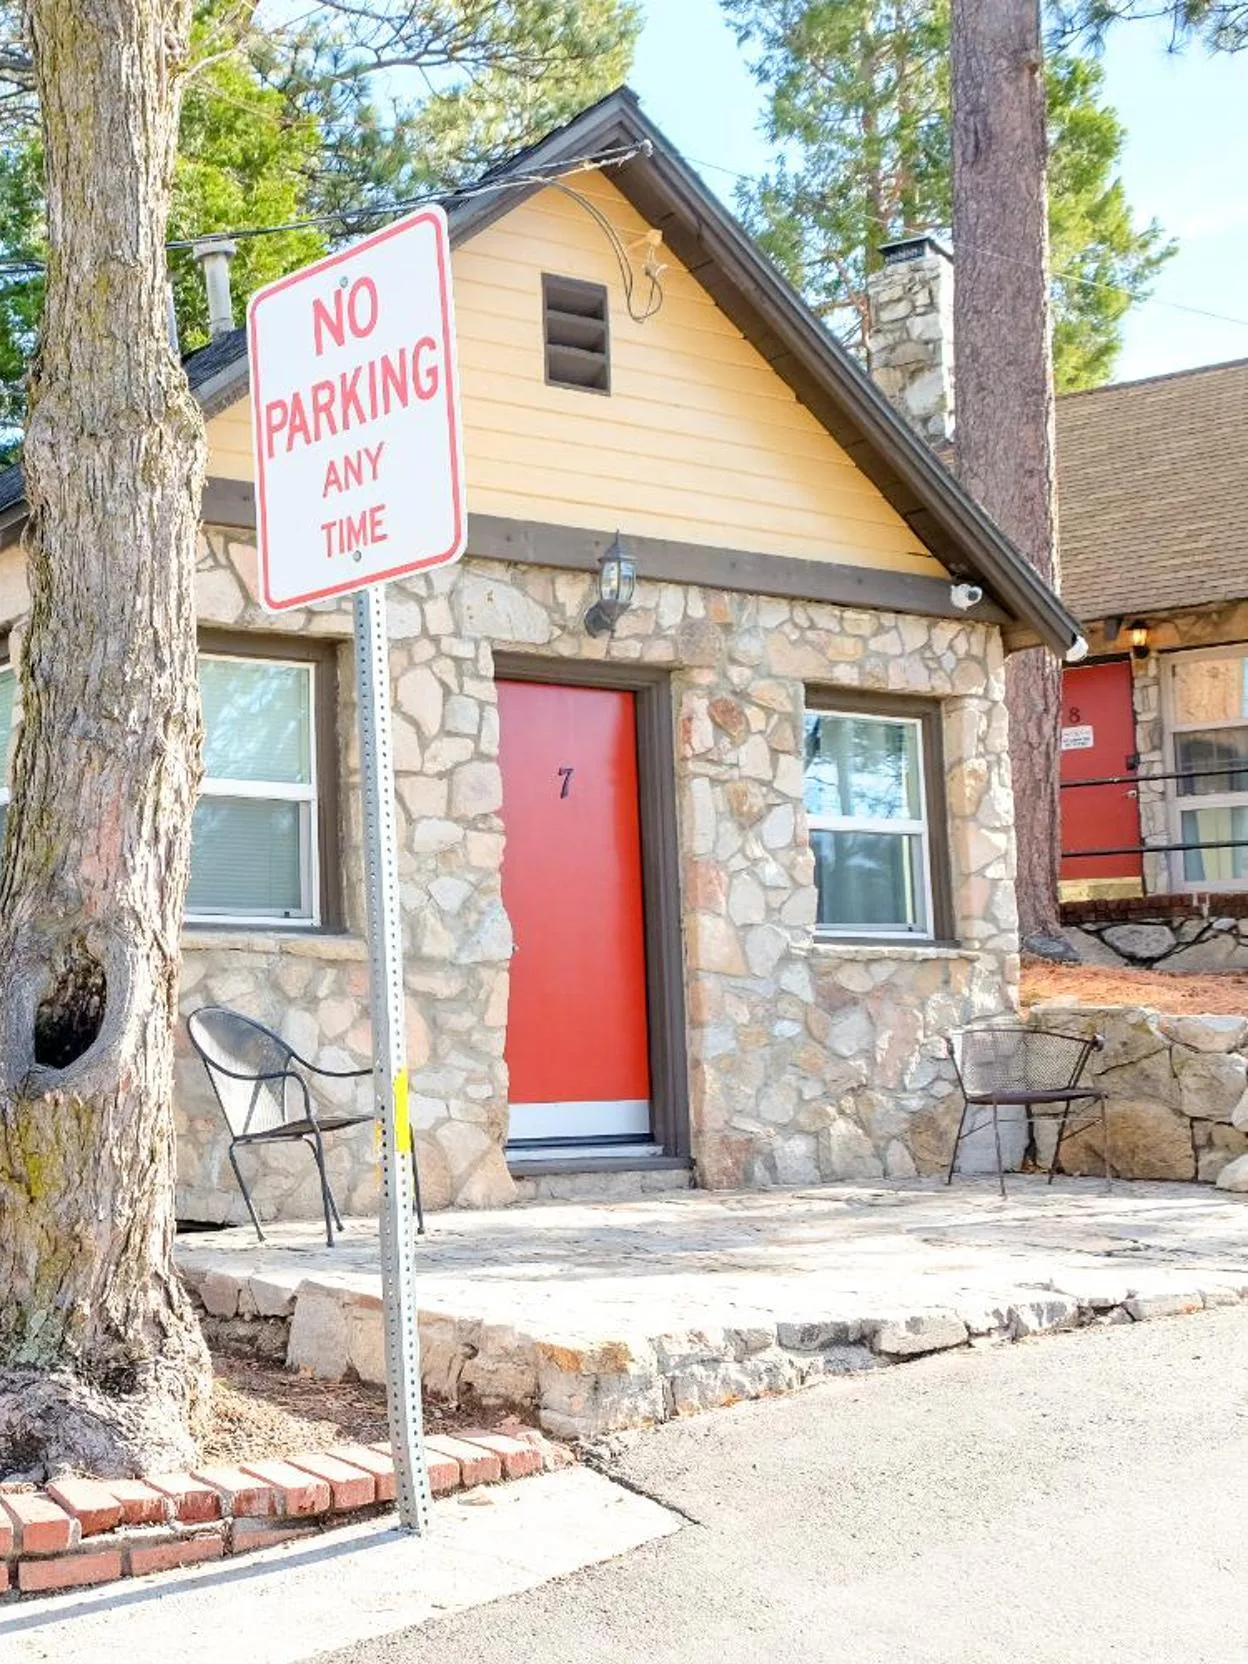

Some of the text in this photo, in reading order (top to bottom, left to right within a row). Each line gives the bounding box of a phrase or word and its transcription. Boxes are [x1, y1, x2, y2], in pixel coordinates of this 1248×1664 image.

[312, 275, 379, 356] NO
[265, 336, 439, 459] PARKING
[322, 441, 386, 498] ANY
[320, 503, 388, 558] TIME
[1068, 706, 1081, 724] 8
[558, 767, 574, 799] 7
